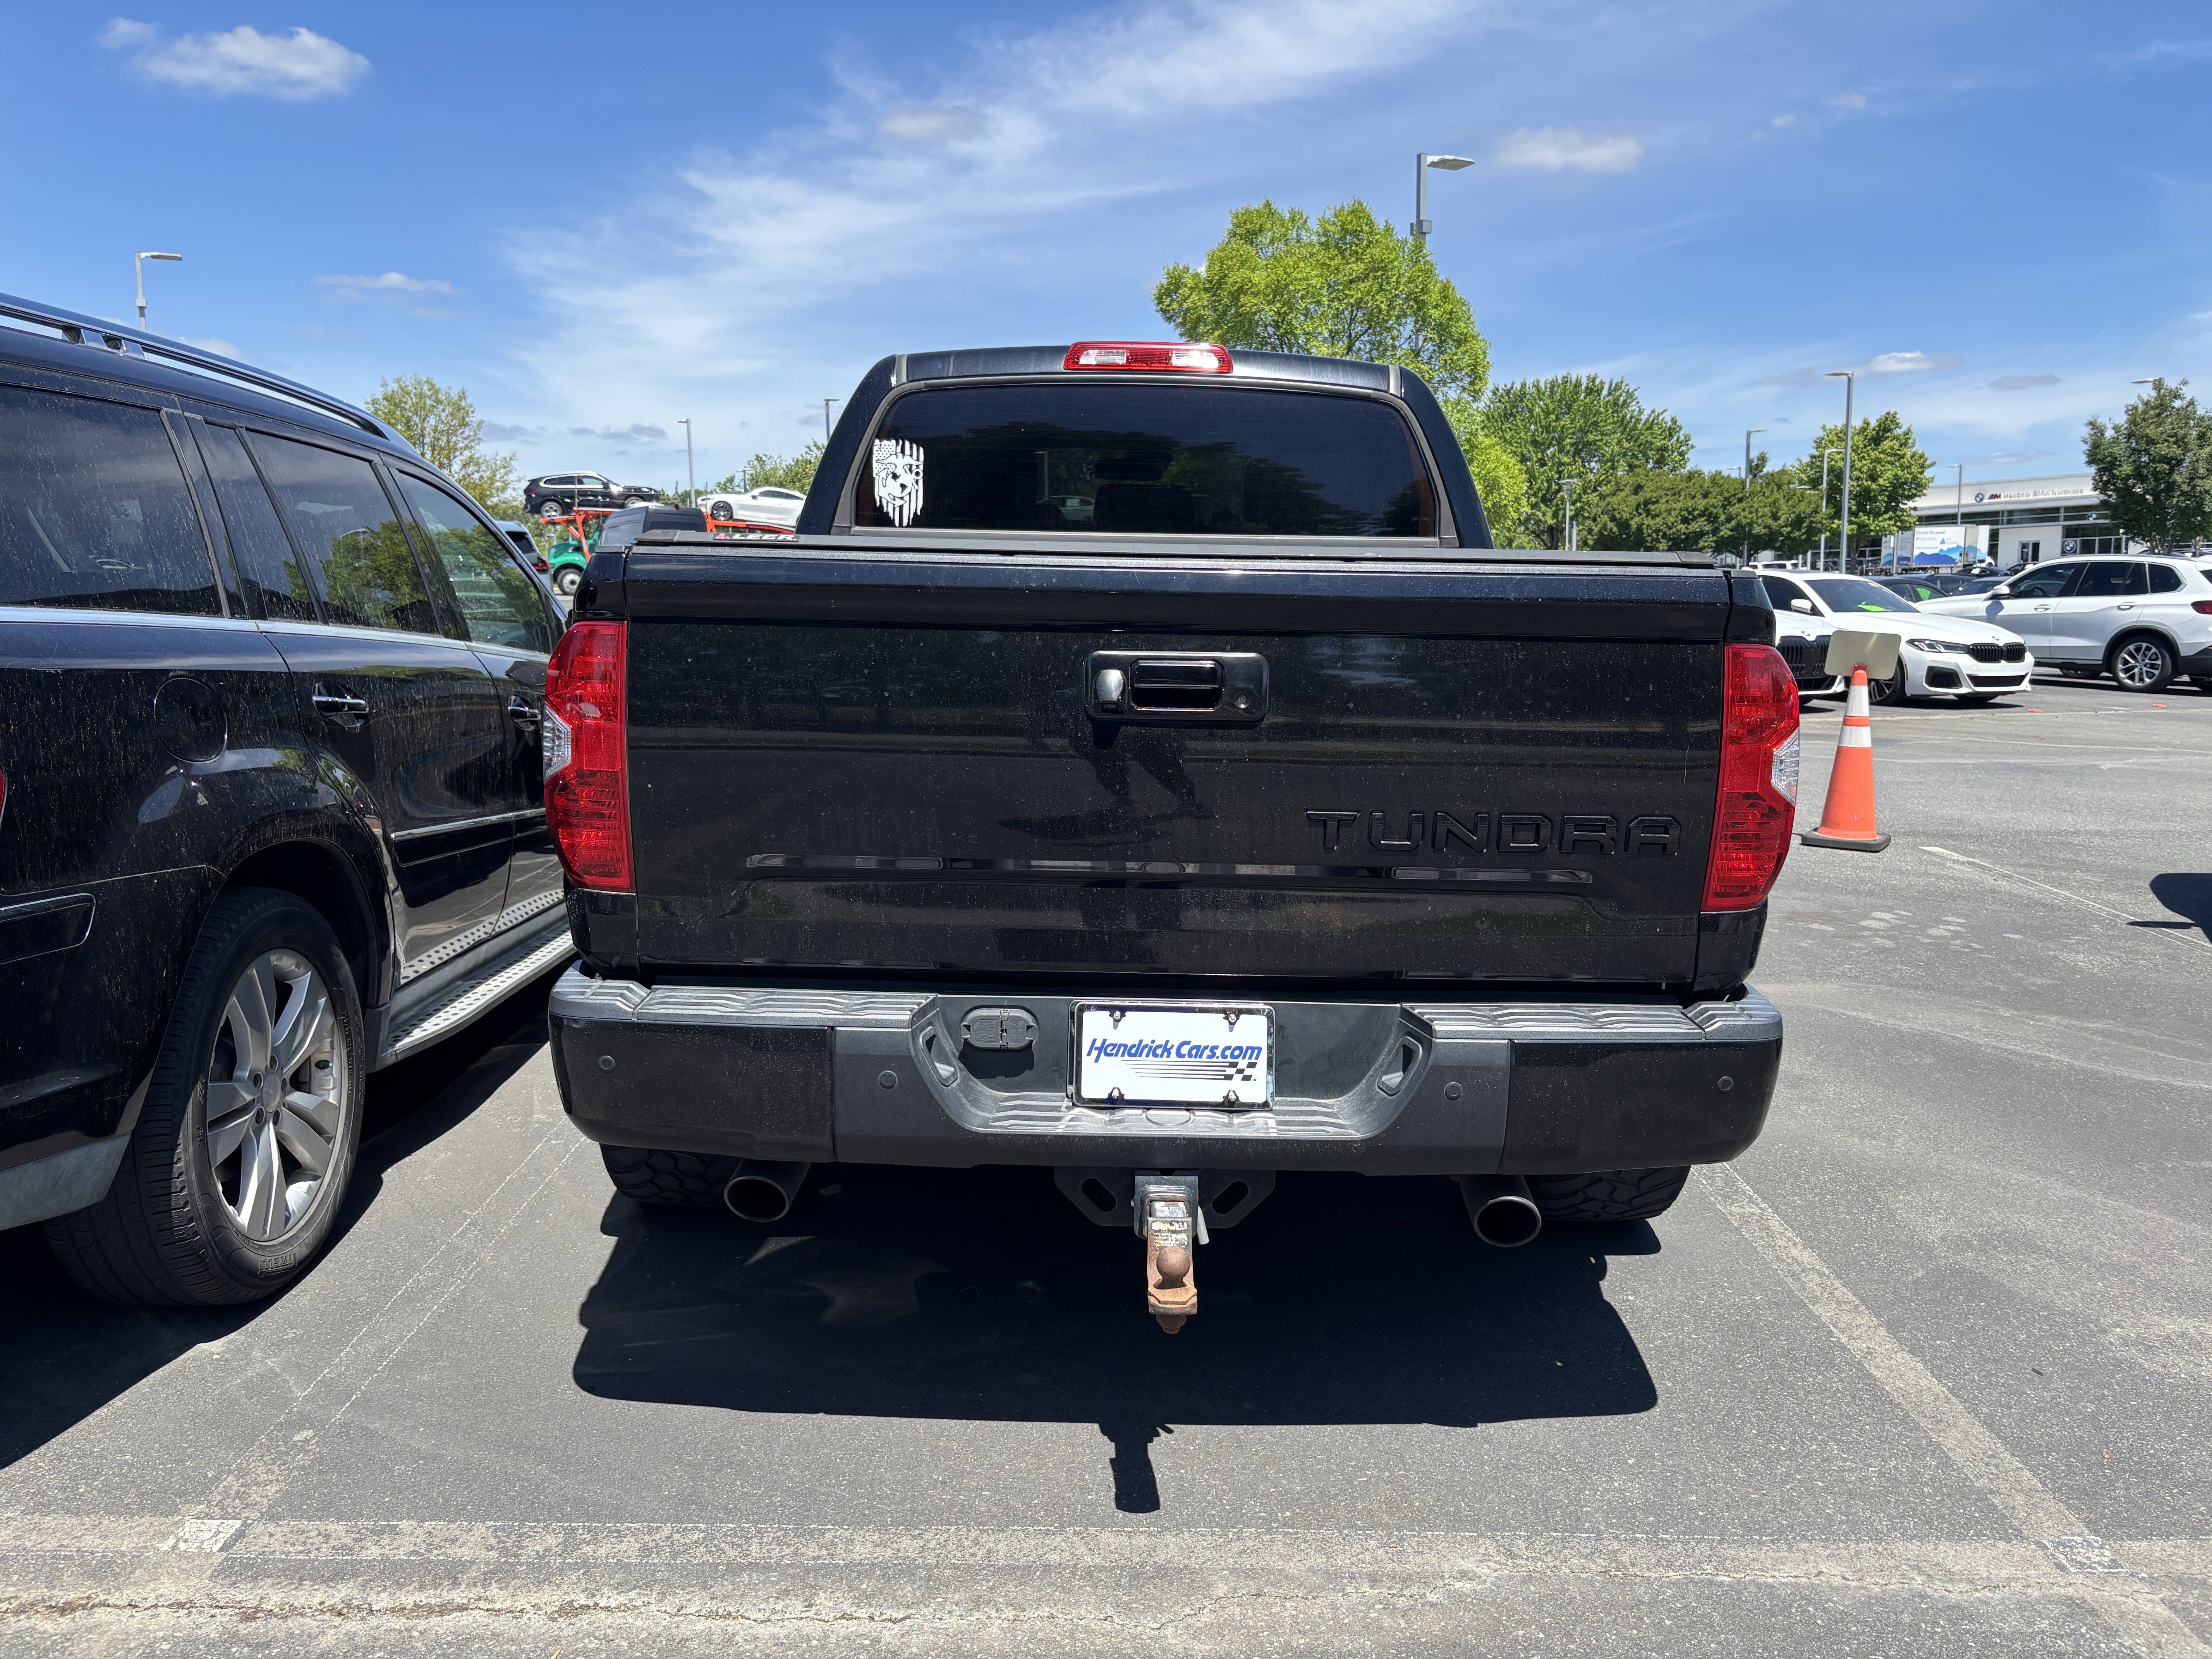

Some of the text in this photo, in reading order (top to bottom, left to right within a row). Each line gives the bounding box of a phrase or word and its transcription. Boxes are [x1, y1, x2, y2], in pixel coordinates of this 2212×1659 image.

[2003, 491, 2031, 499] Hendrick
[1304, 809, 1681, 856] TUNDRA
[1087, 1038, 1262, 1063] HendrickCars.com
[258, 1252, 298, 1277] PIRELLI
